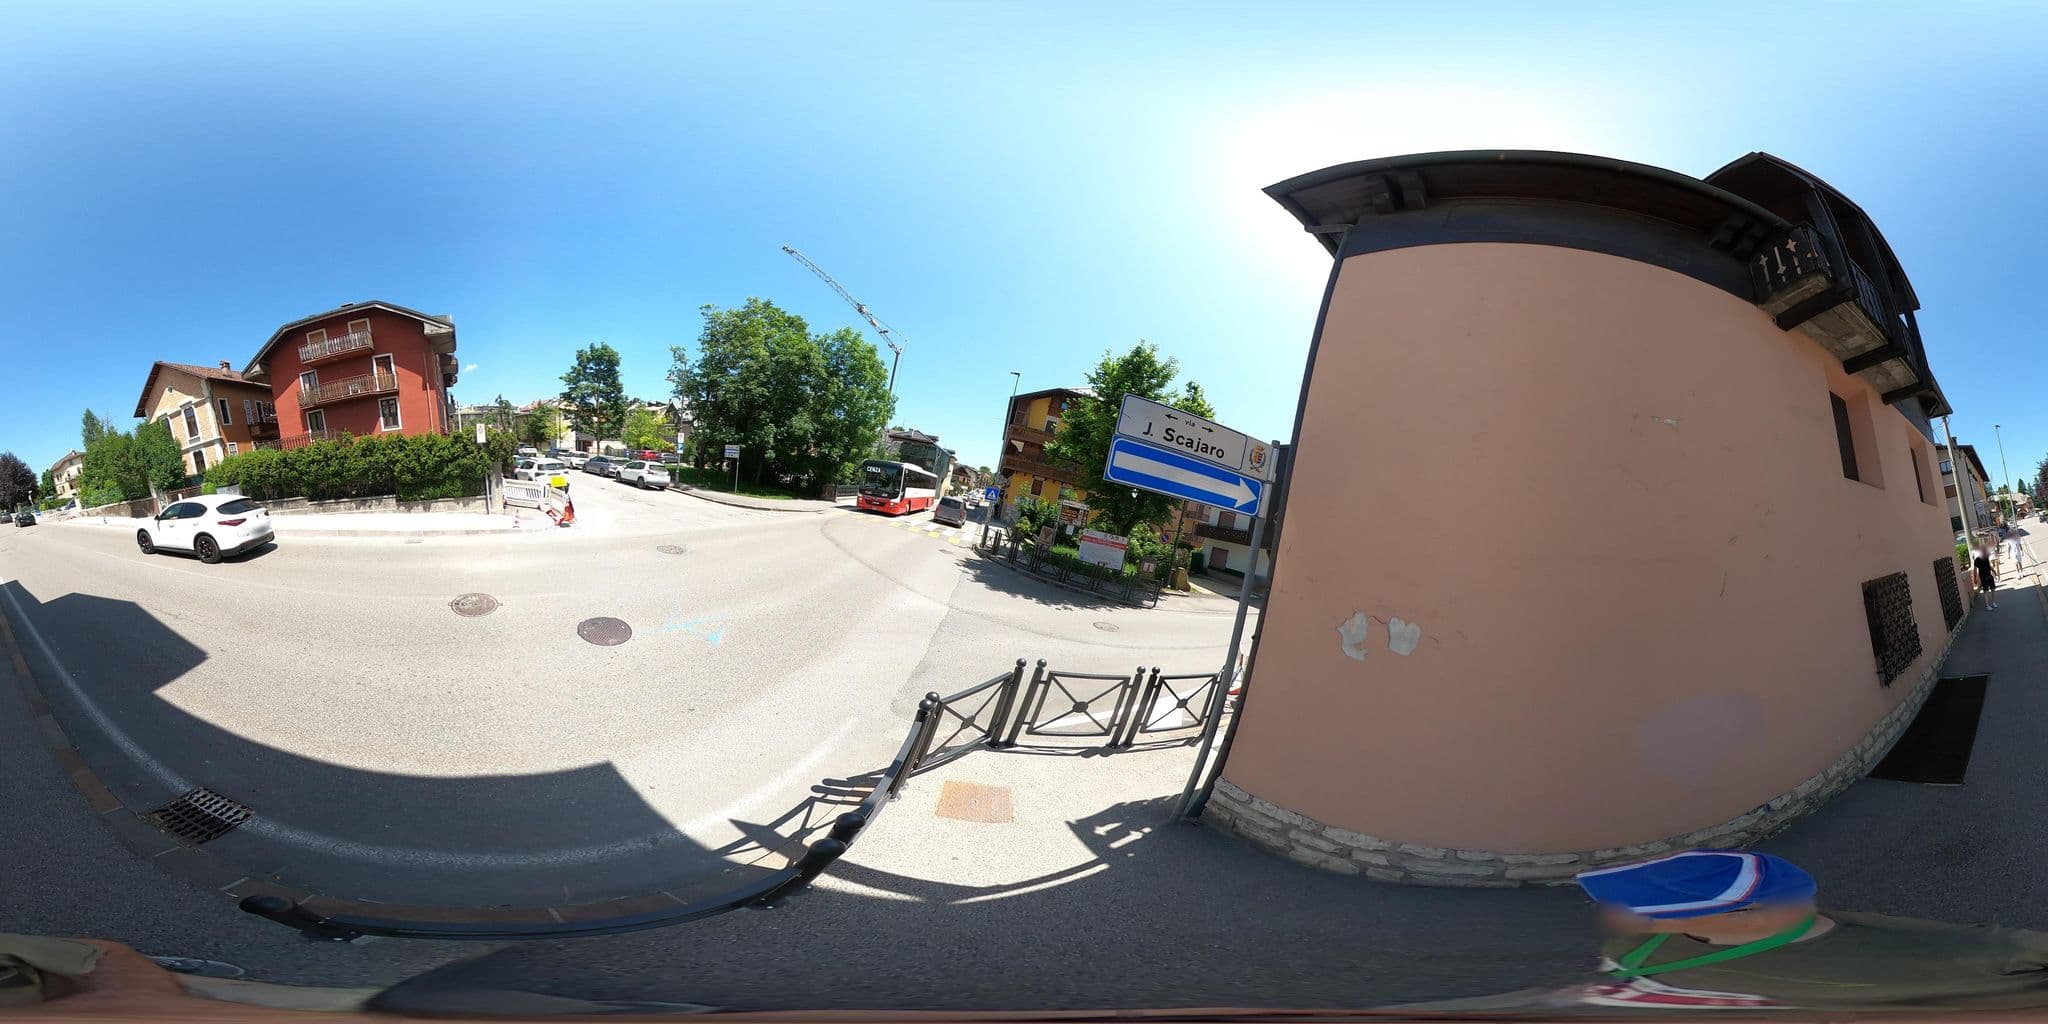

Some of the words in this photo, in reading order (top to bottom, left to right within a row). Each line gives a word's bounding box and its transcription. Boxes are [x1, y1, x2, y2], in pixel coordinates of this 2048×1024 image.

[1185, 419, 1195, 427] via
[1143, 422, 1153, 436] J.
[1163, 428, 1225, 458] Scajaro
